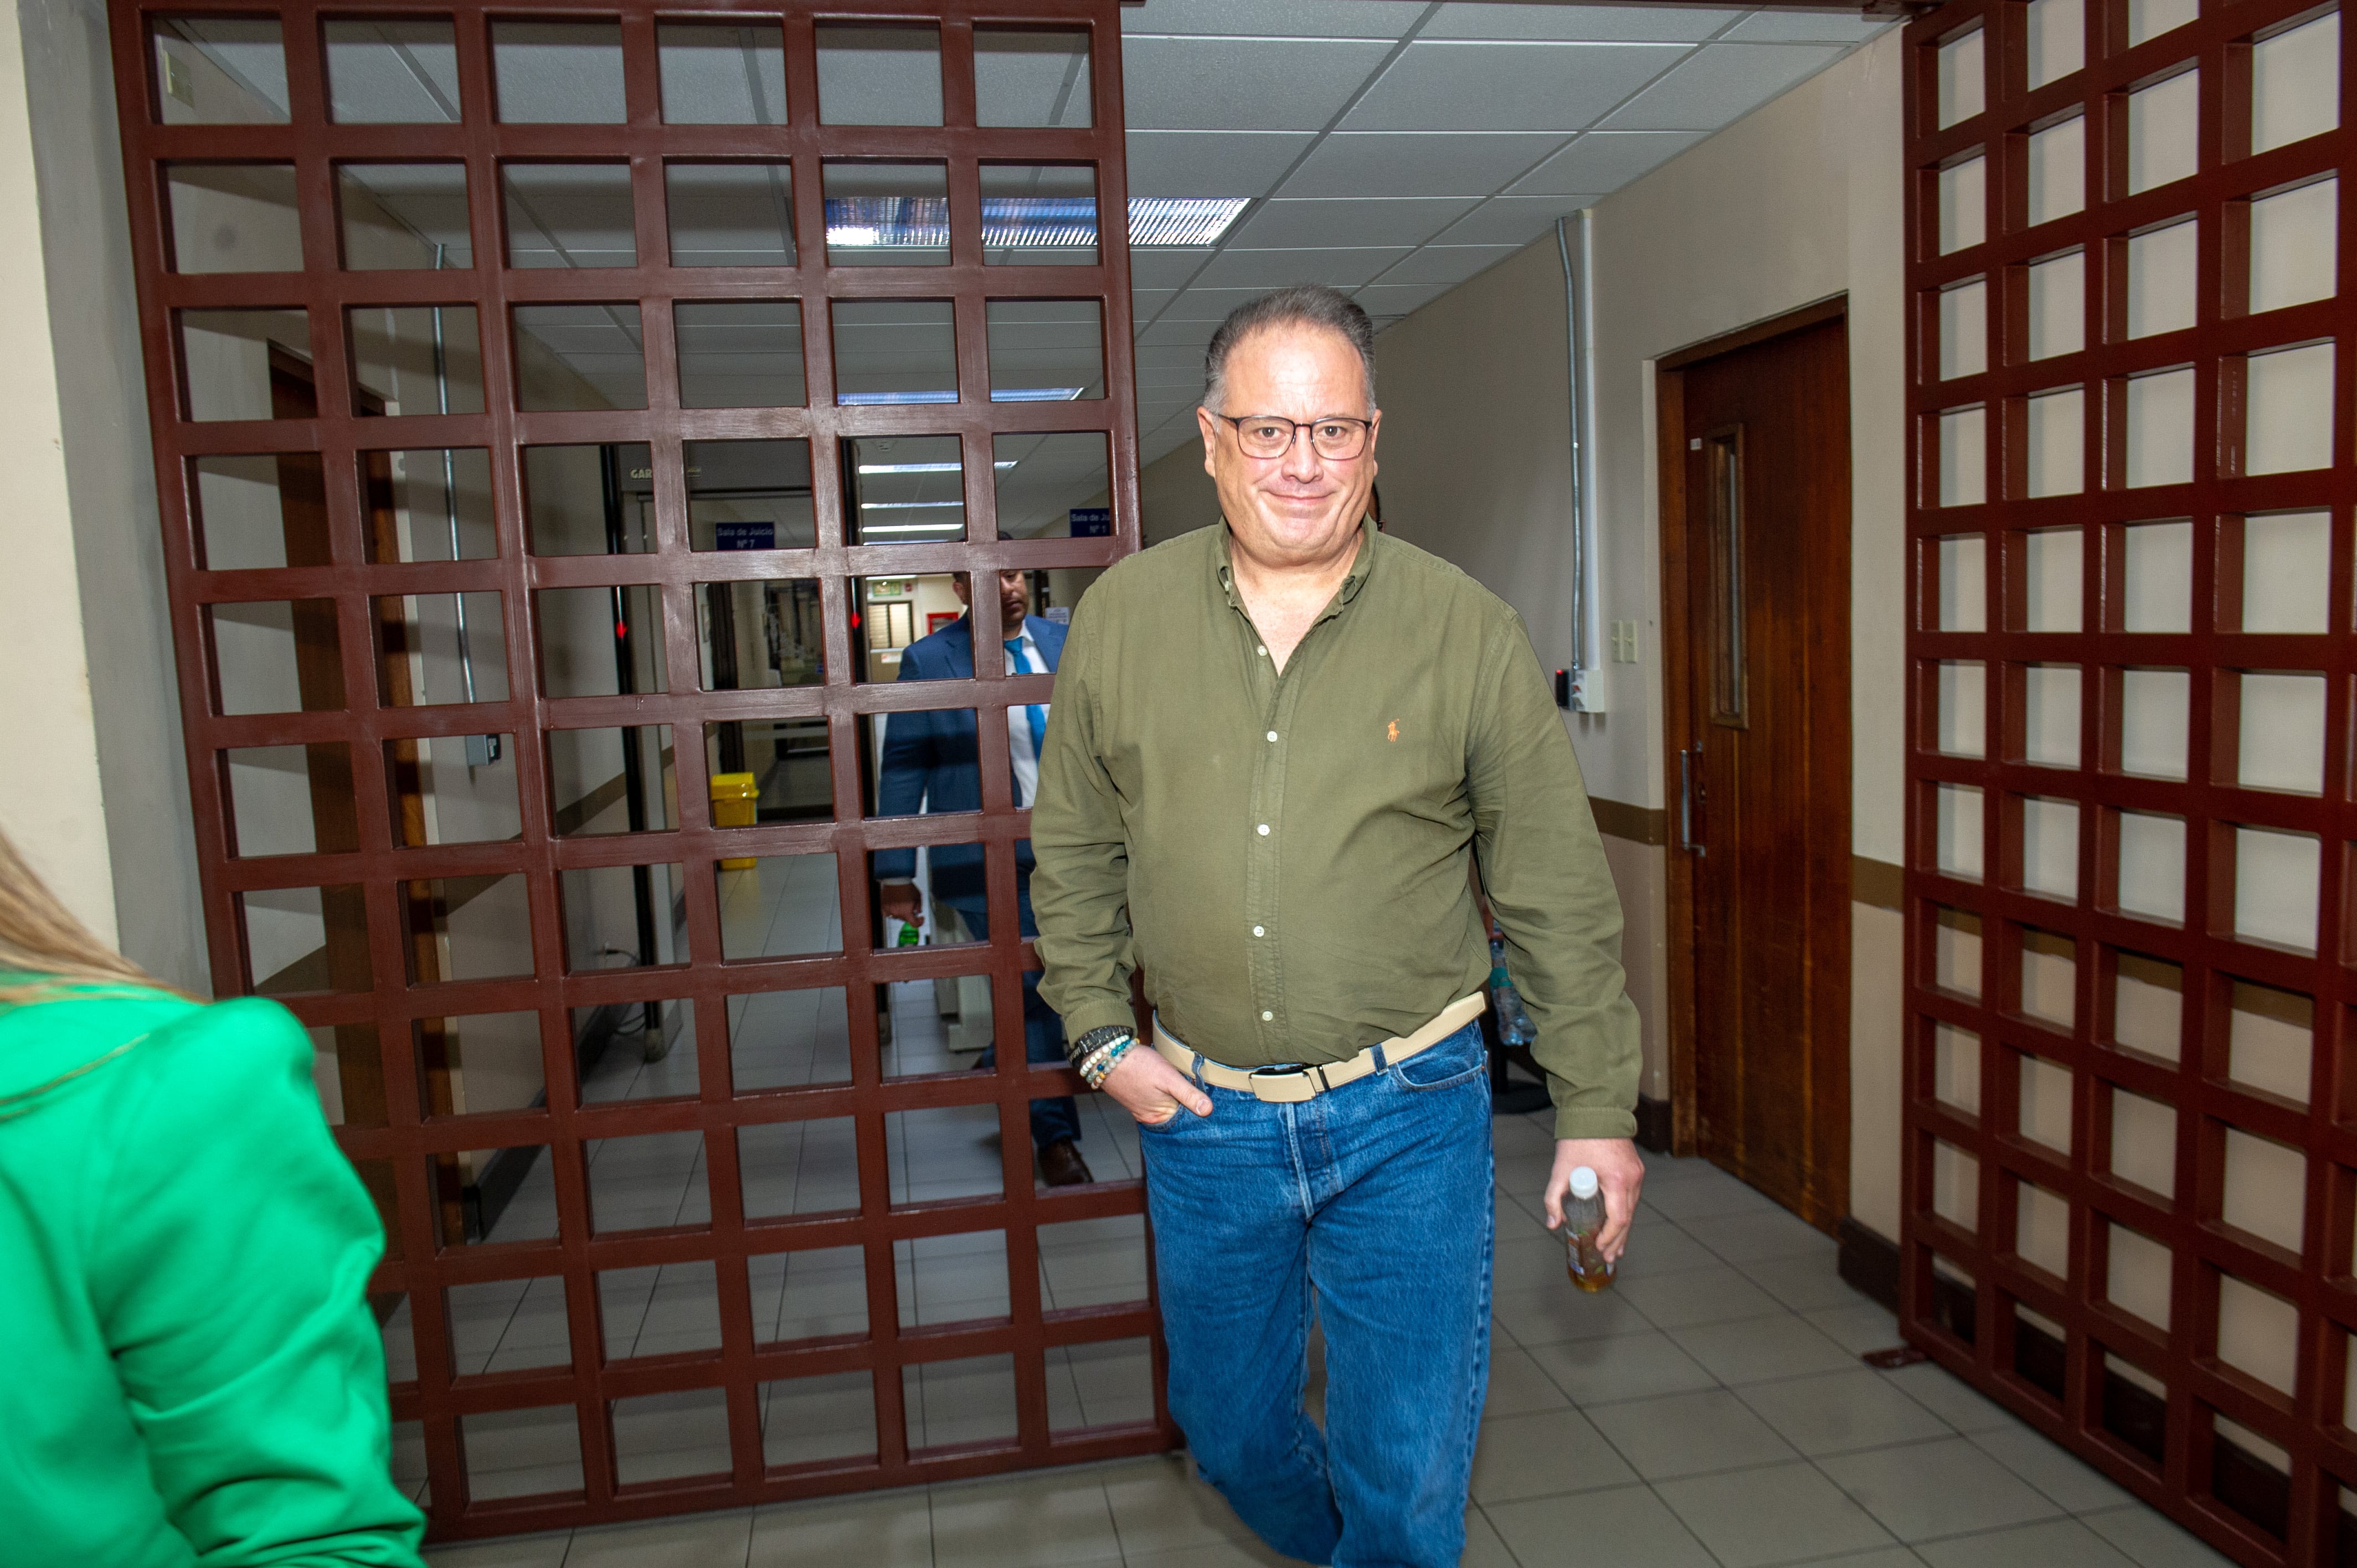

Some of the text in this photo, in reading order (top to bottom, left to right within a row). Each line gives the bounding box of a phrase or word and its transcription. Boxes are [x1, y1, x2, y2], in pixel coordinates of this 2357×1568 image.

[631, 468, 652, 479] GAR
[737, 527, 747, 536] de
[749, 527, 773, 536] Juicio
